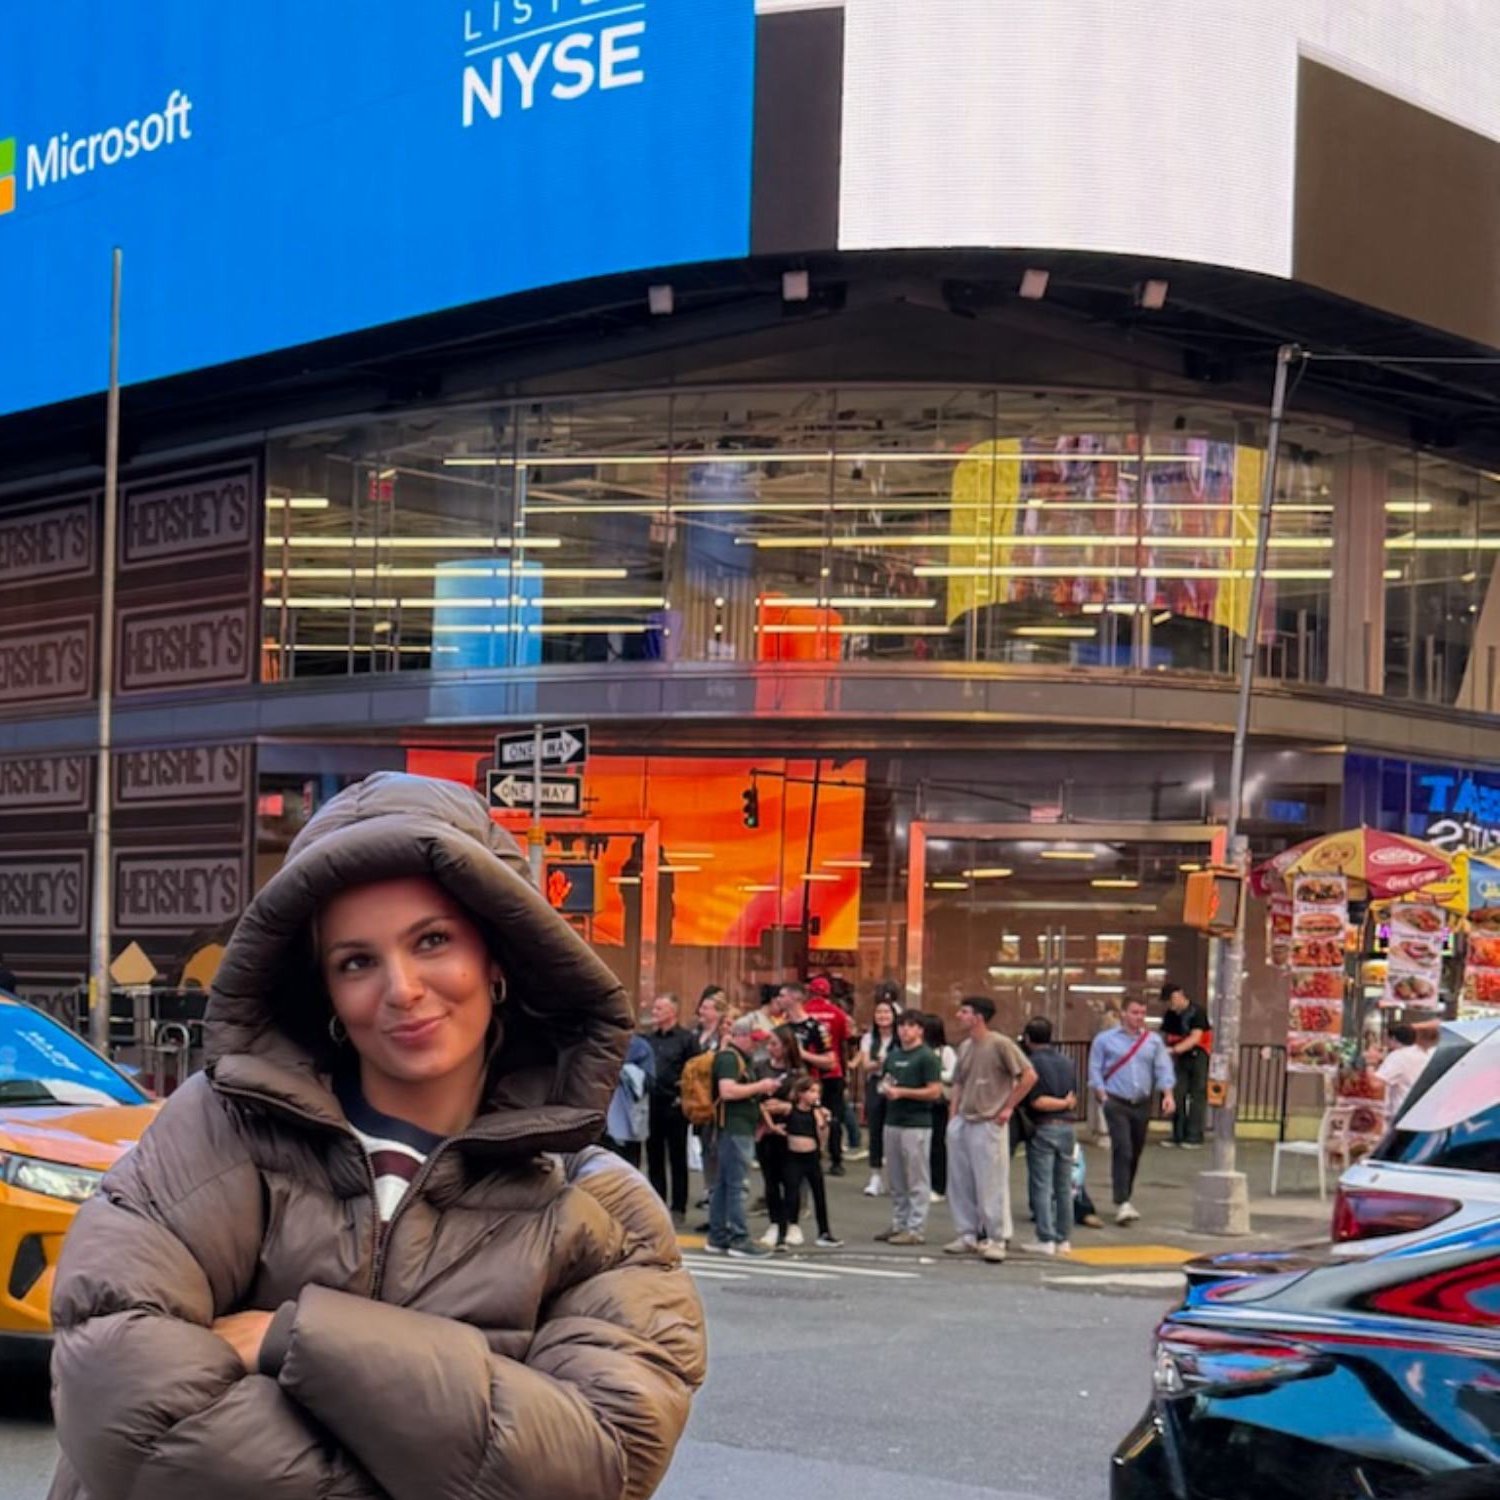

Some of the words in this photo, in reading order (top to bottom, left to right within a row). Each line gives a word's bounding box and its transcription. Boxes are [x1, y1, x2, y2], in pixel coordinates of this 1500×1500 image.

[465, 0, 604, 41] LIS
[463, 21, 645, 127] NYSE
[27, 89, 192, 191] Microsoft
[128, 484, 247, 548] HERSHEY'S
[126, 615, 243, 676] HERSHEY'S
[509, 743, 534, 760] ONE
[546, 740, 573, 756] WAY
[501, 783, 528, 800] ONE
[541, 786, 569, 800] WAY
[121, 863, 237, 917] HERSHEY'S
